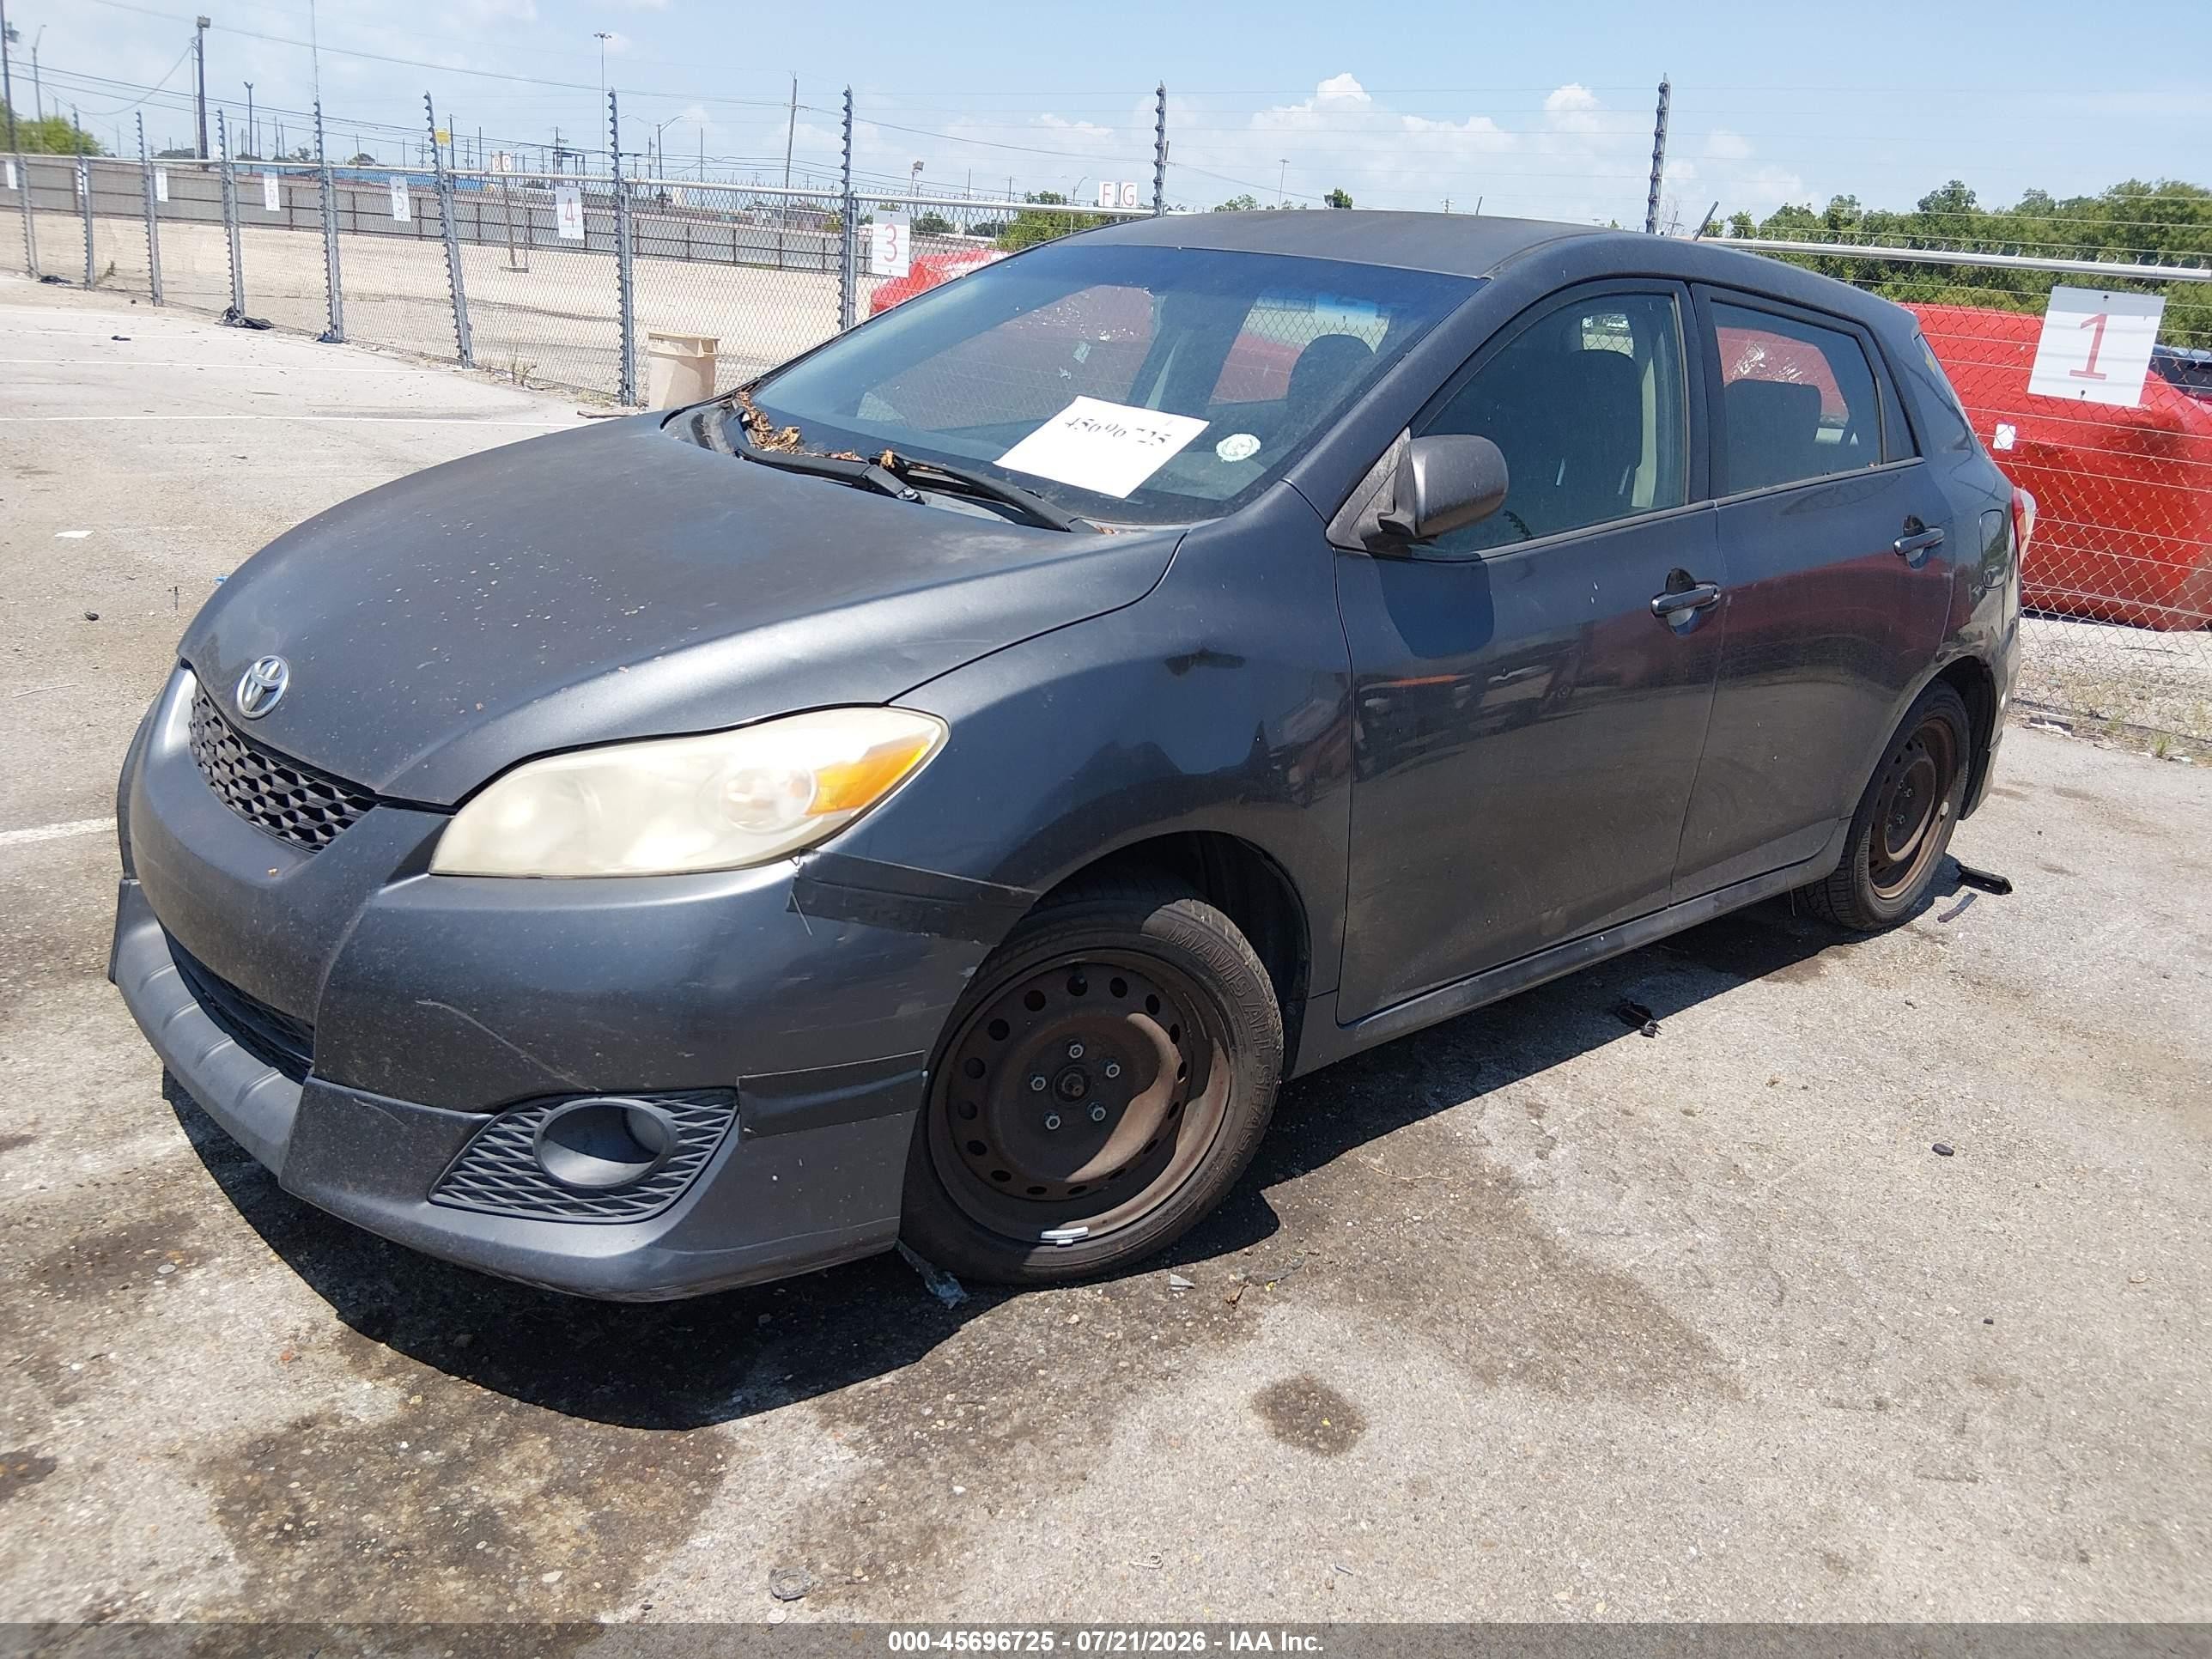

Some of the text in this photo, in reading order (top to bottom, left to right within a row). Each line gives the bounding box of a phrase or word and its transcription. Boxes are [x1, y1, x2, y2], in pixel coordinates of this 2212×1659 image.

[396, 185, 404, 211] 5
[1103, 183, 1112, 206] F
[1122, 184, 1134, 206] G
[564, 197, 576, 228] 4
[884, 222, 898, 263] 3
[2069, 312, 2109, 380] 1
[1166, 921, 1253, 997] MAVIS
[1241, 1002, 1272, 1058] ALL
